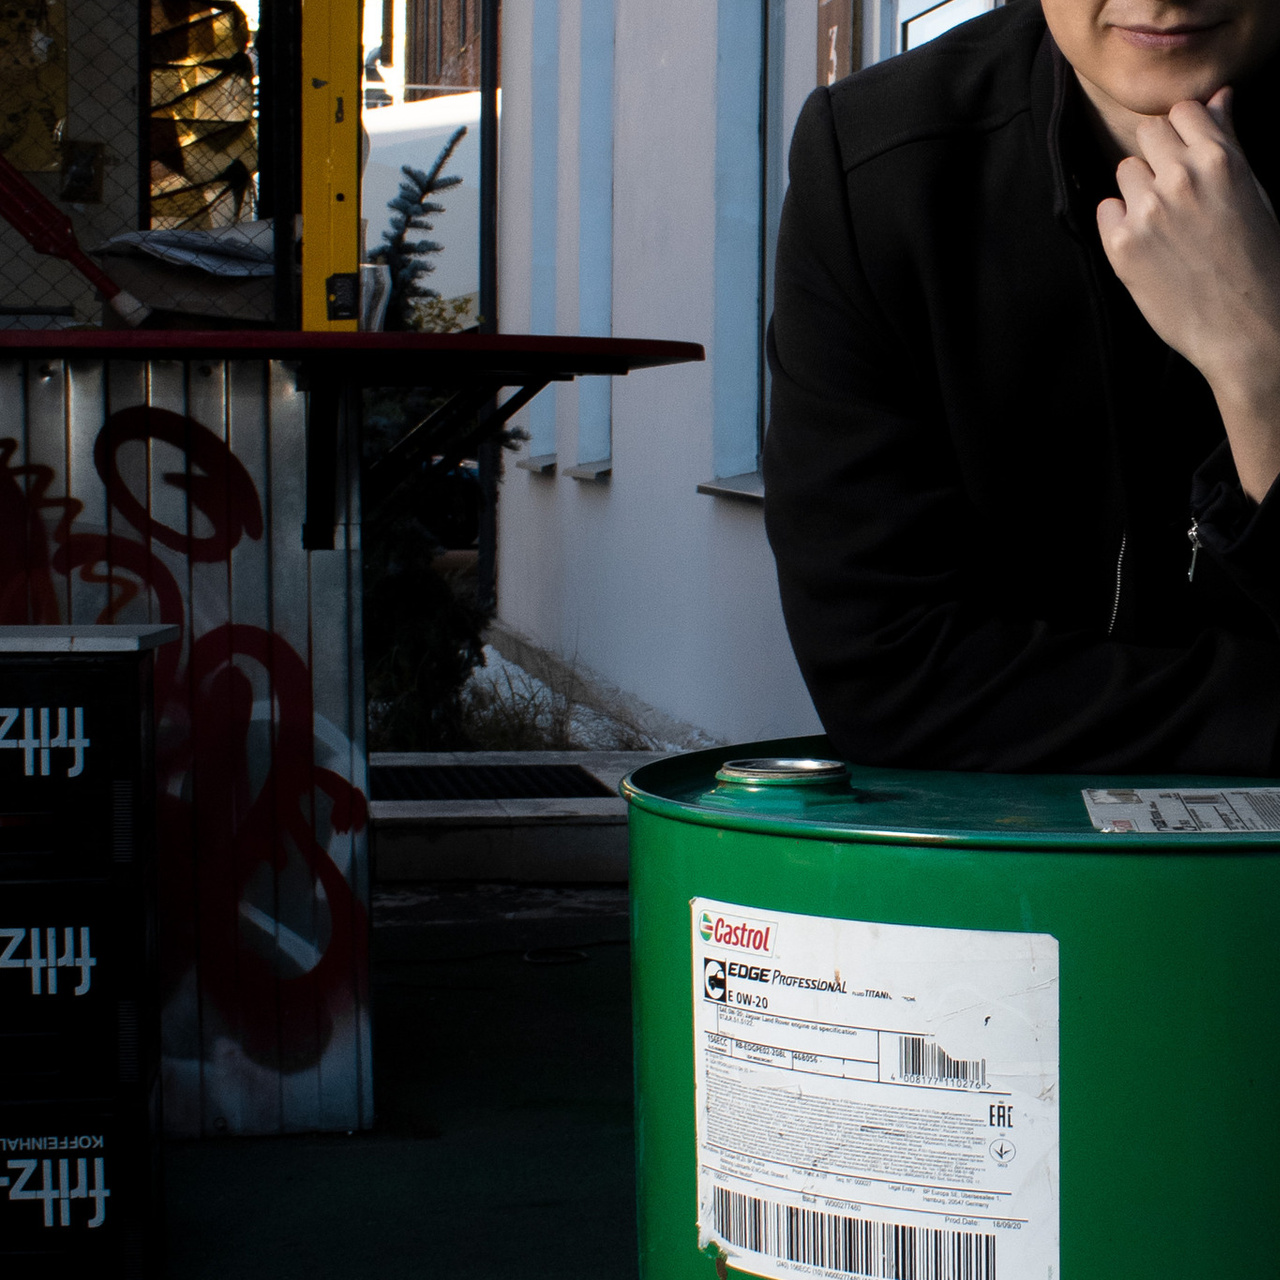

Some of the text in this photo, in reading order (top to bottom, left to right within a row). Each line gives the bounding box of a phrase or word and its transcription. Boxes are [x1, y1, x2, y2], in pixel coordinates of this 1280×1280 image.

[714, 916, 771, 952] Castrol
[728, 962, 772, 983] EDGE
[728, 990, 769, 1010] E 0W-20
[762, 1015, 774, 1024] Land
[775, 1017, 790, 1026] Rover
[791, 1021, 810, 1030] engine
[819, 1024, 858, 1036] specification
[890, 1073, 981, 1089] 4 008177 110276
[931, 1189, 949, 1198] Europa
[965, 1199, 989, 1209] Germany
